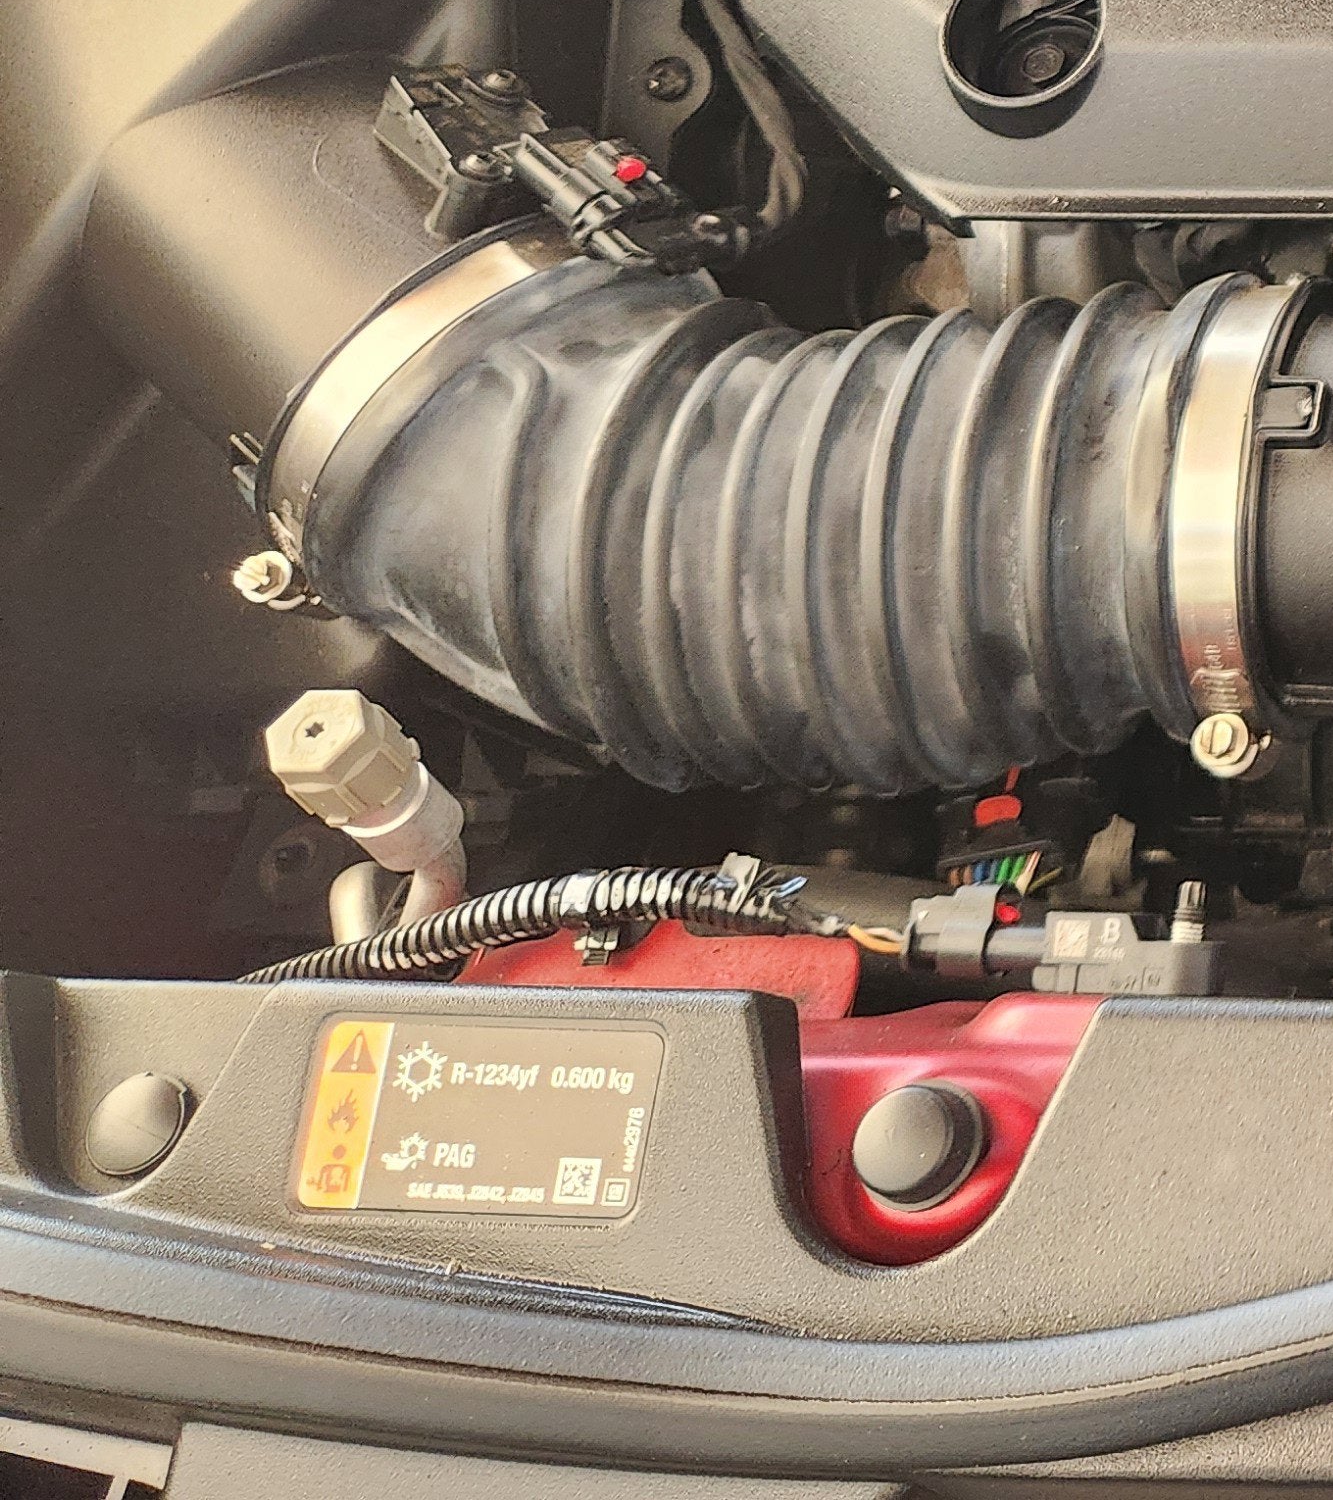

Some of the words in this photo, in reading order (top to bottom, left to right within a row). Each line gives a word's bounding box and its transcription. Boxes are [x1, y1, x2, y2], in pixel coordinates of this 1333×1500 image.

[450, 1062, 541, 1091] R-1234yf
[550, 1066, 606, 1089] 0.600
[607, 1068, 635, 1094] kg
[432, 1143, 476, 1169] PAG
[406, 1182, 433, 1199] SAE
